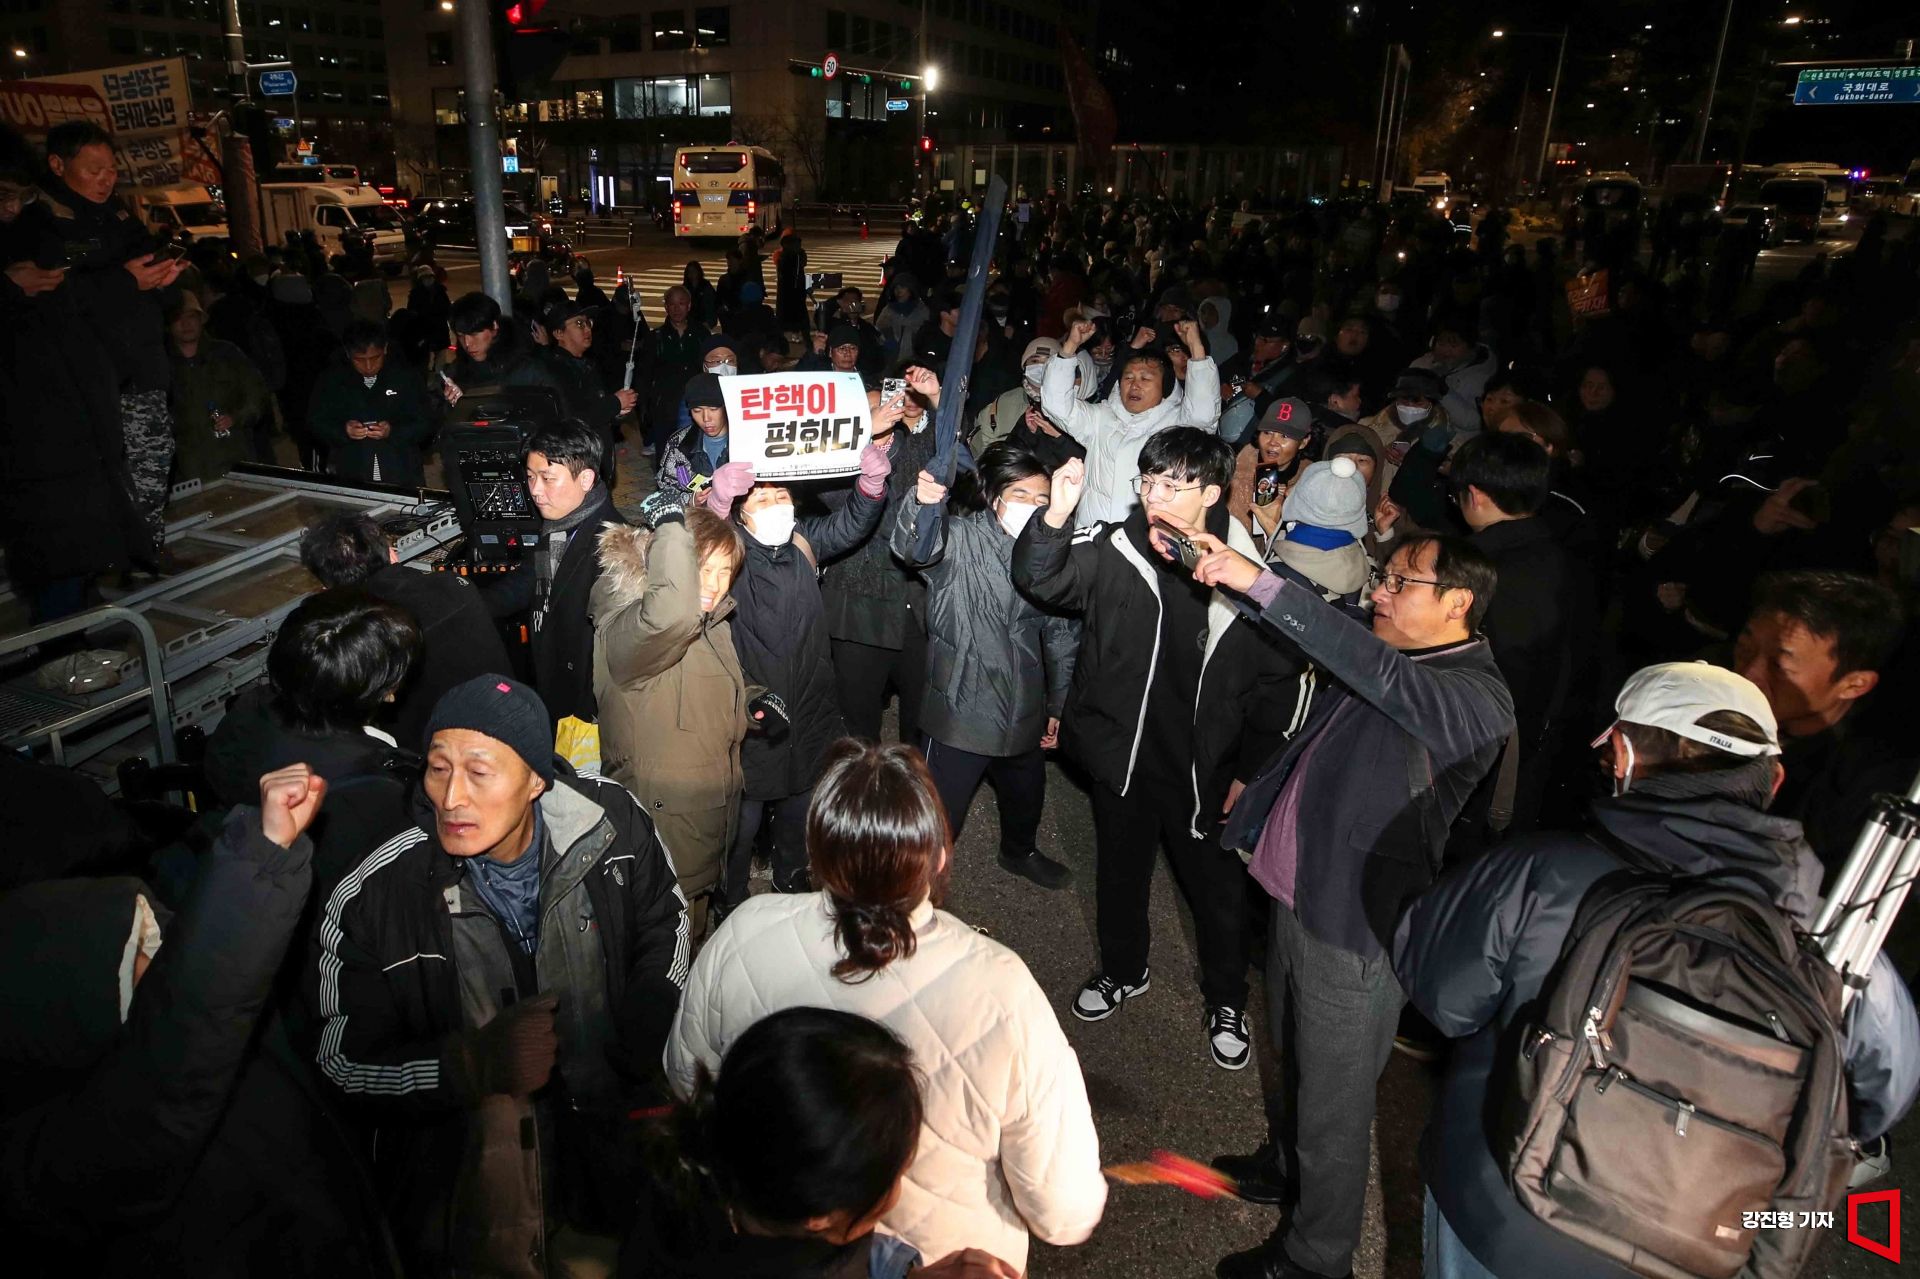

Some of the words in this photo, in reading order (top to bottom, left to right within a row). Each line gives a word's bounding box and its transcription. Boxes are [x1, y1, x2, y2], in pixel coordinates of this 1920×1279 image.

[826, 61, 836, 73] 50
[1857, 70, 1891, 79] 여의도역
[1842, 82, 1890, 93] 국회대로
[1834, 92, 1894, 101] Gukhoe-daero
[740, 382, 836, 421] 탄핵이
[1276, 402, 1293, 421] B
[764, 416, 864, 458] 평화다
[1709, 735, 1733, 749] ITALIA
